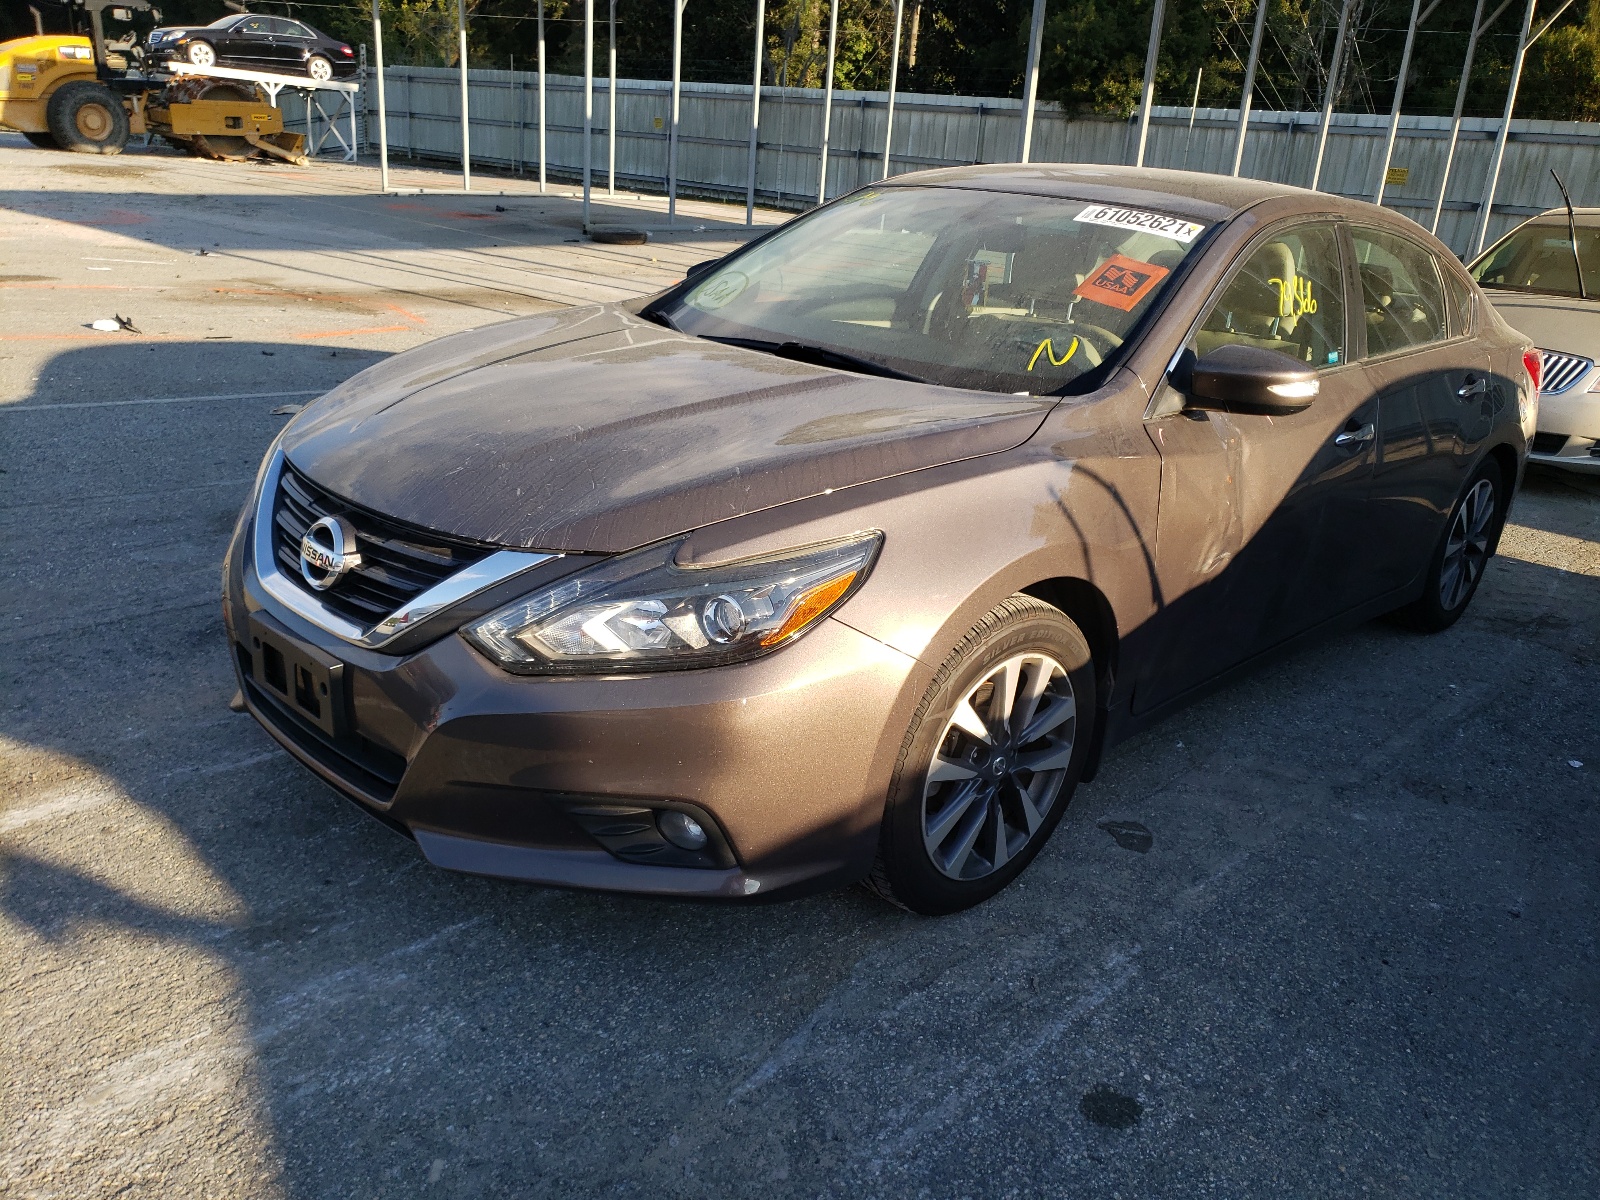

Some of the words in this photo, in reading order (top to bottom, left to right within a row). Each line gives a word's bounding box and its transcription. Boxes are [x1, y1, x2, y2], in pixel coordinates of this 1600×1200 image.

[1094, 207, 1186, 234] 61052621
[1095, 279, 1128, 294] USAA
[303, 542, 334, 567] NISSAN
[982, 632, 1026, 666] SILVER
